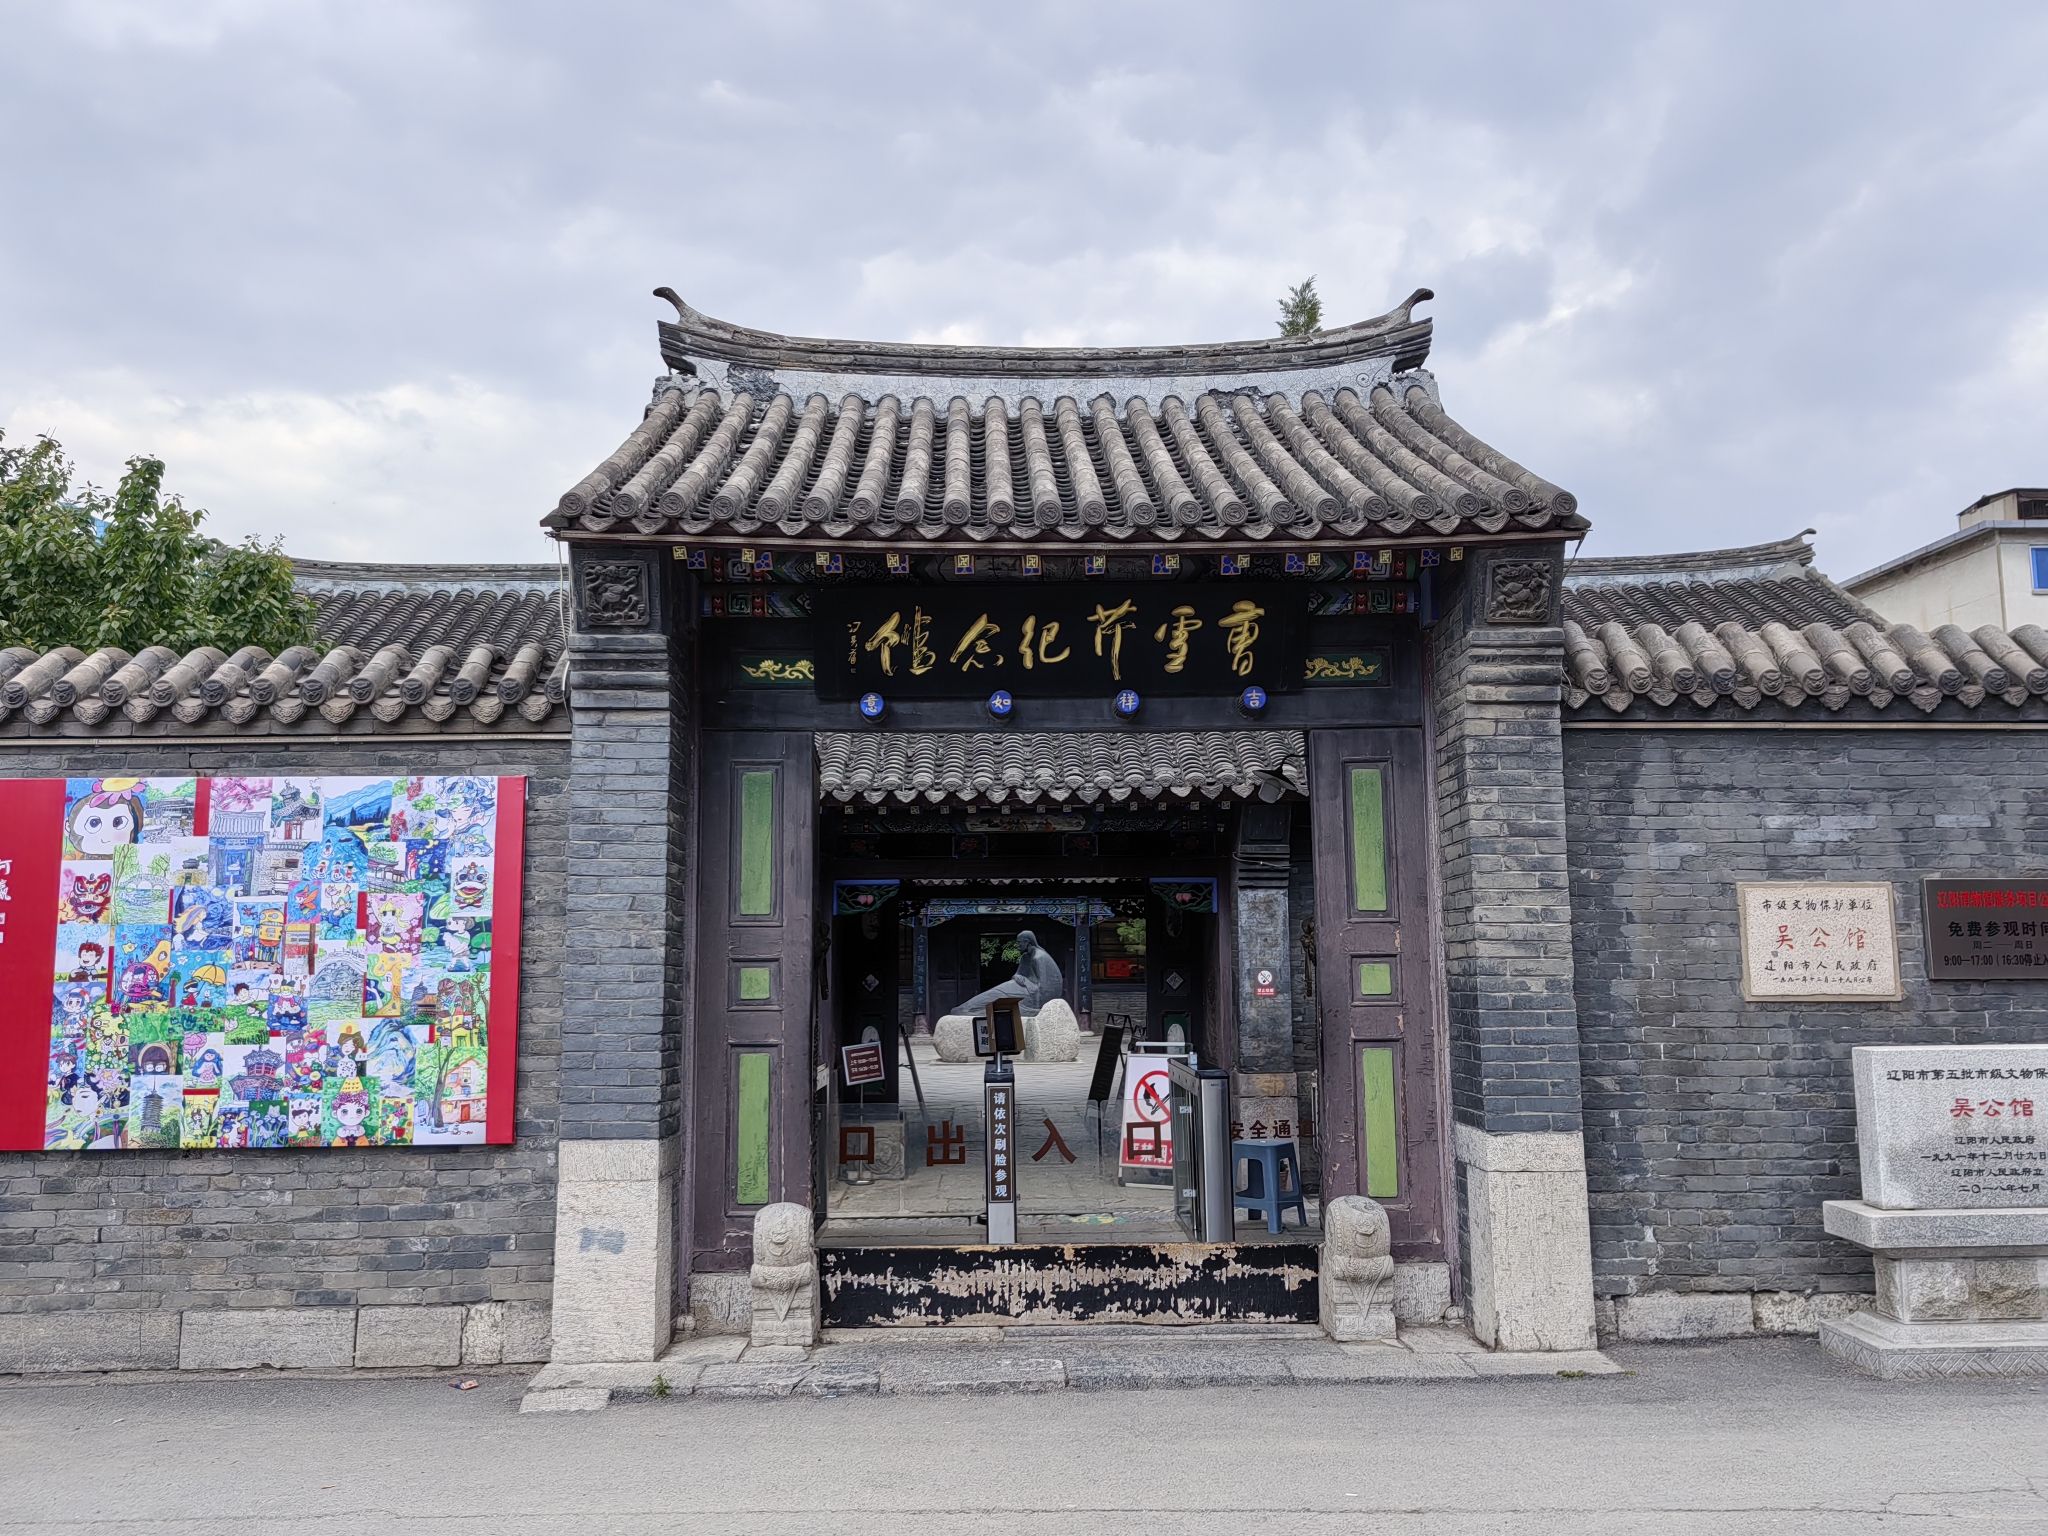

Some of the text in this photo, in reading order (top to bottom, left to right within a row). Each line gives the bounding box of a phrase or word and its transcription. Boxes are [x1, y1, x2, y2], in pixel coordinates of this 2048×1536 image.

[1762, 899, 1873, 912] 市级文物保护单位
[1776, 925, 1866, 951] 吴公馆
[1765, 959, 1877, 972] 辽阳市人民政府
[1887, 1068, 2048, 1081] 辽阳市第五批市级文物保
[1950, 1098, 2034, 1118] 吴公馆
[994, 1092, 1008, 1197] 请依次刷脸参观
[1955, 1136, 2036, 1144] 辽阳市人民政府
[1951, 1168, 2045, 1177] 辽阳市人民政府立
